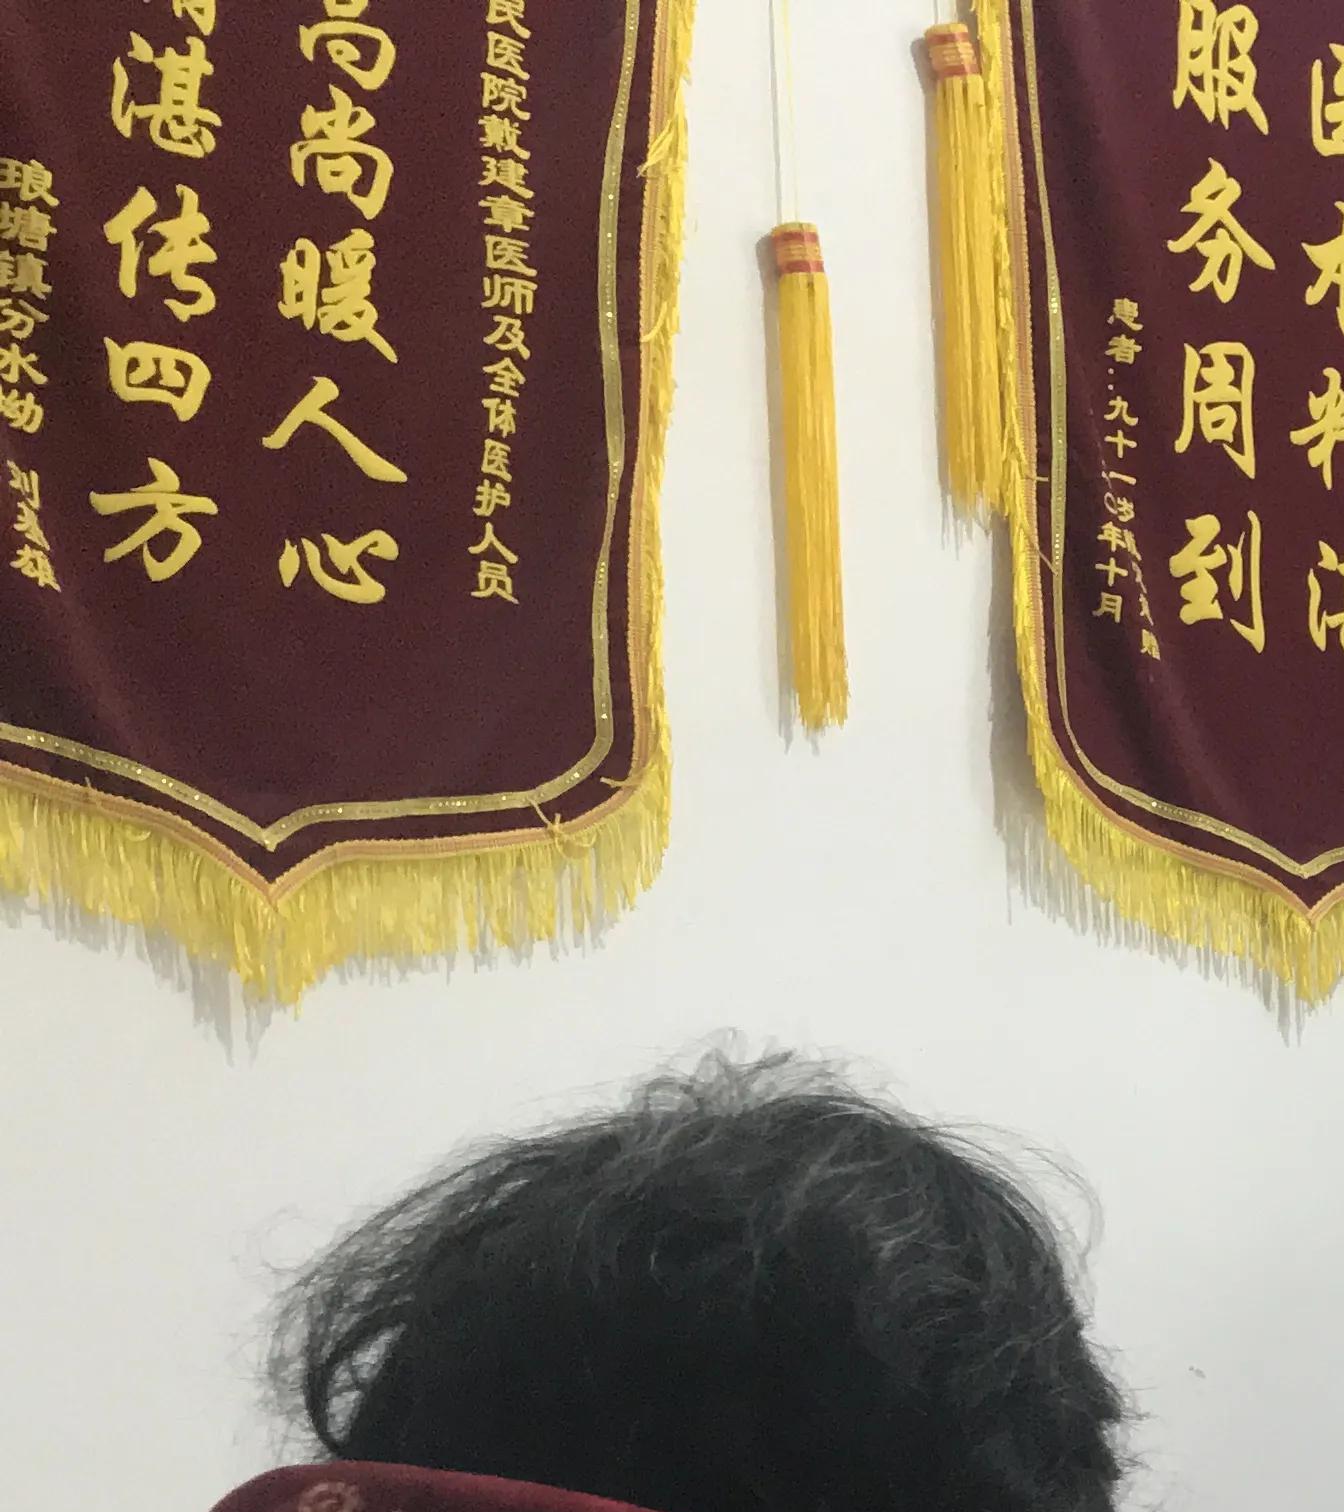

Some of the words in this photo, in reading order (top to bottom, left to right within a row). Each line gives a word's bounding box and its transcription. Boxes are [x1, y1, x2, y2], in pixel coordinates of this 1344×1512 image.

[262, 0, 408, 605] 高尚暖人心
[1168, 0, 1276, 654] 服务周到
